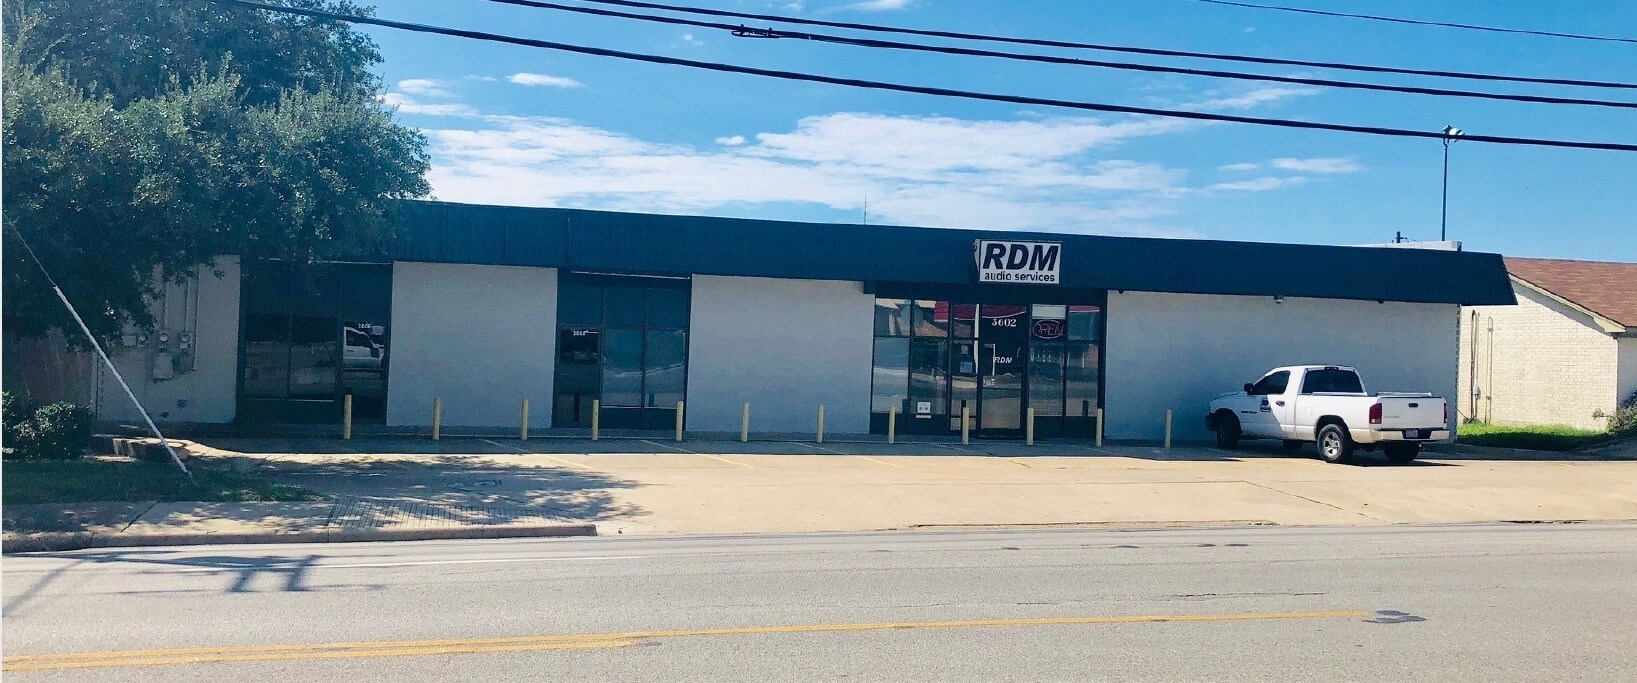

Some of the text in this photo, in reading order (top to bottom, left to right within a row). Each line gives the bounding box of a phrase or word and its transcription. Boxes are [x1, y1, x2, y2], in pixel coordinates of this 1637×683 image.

[982, 243, 1059, 270] RDM
[984, 271, 1055, 282] audio services
[991, 318, 1017, 327] 3602
[1034, 323, 1064, 336] OPEN
[994, 356, 1013, 364] RDM
